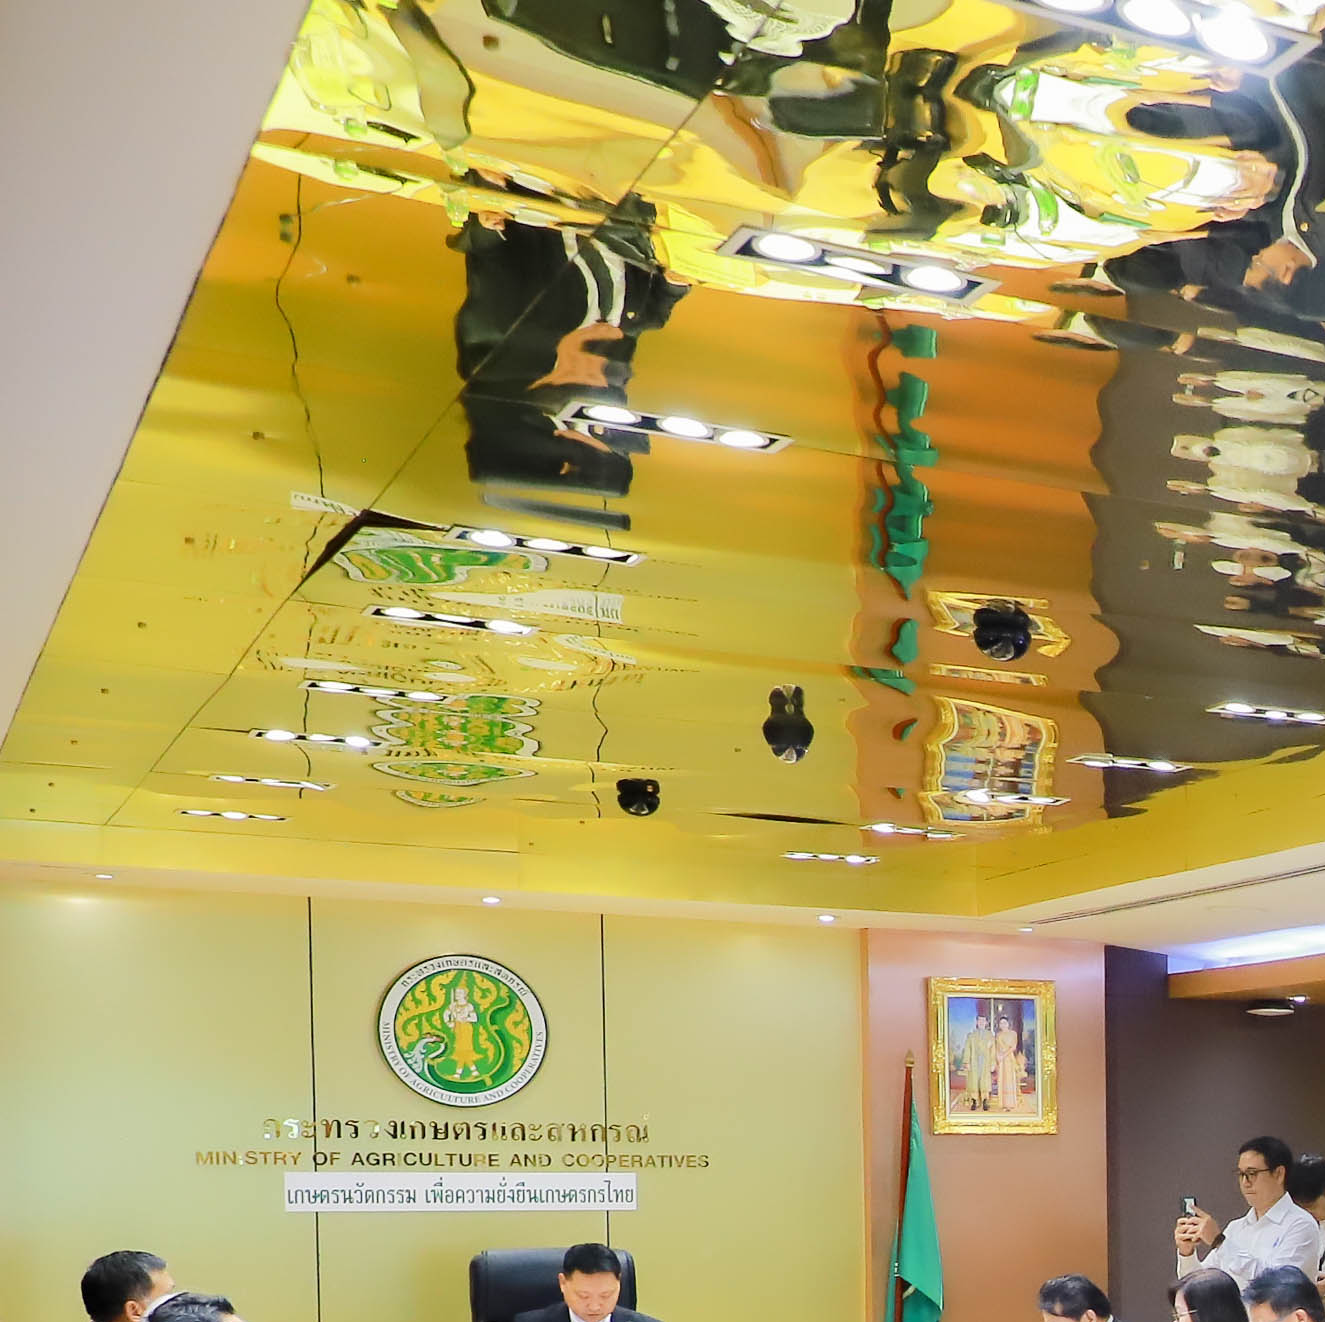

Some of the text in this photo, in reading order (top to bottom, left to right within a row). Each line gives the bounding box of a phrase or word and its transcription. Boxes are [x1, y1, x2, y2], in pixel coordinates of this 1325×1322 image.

[263, 1113, 650, 1143] กระทรวงเกษตรและสหกรณ์
[195, 1150, 710, 1169] MINISTRY OF AGRICULTURE AND COOPERATIVES
